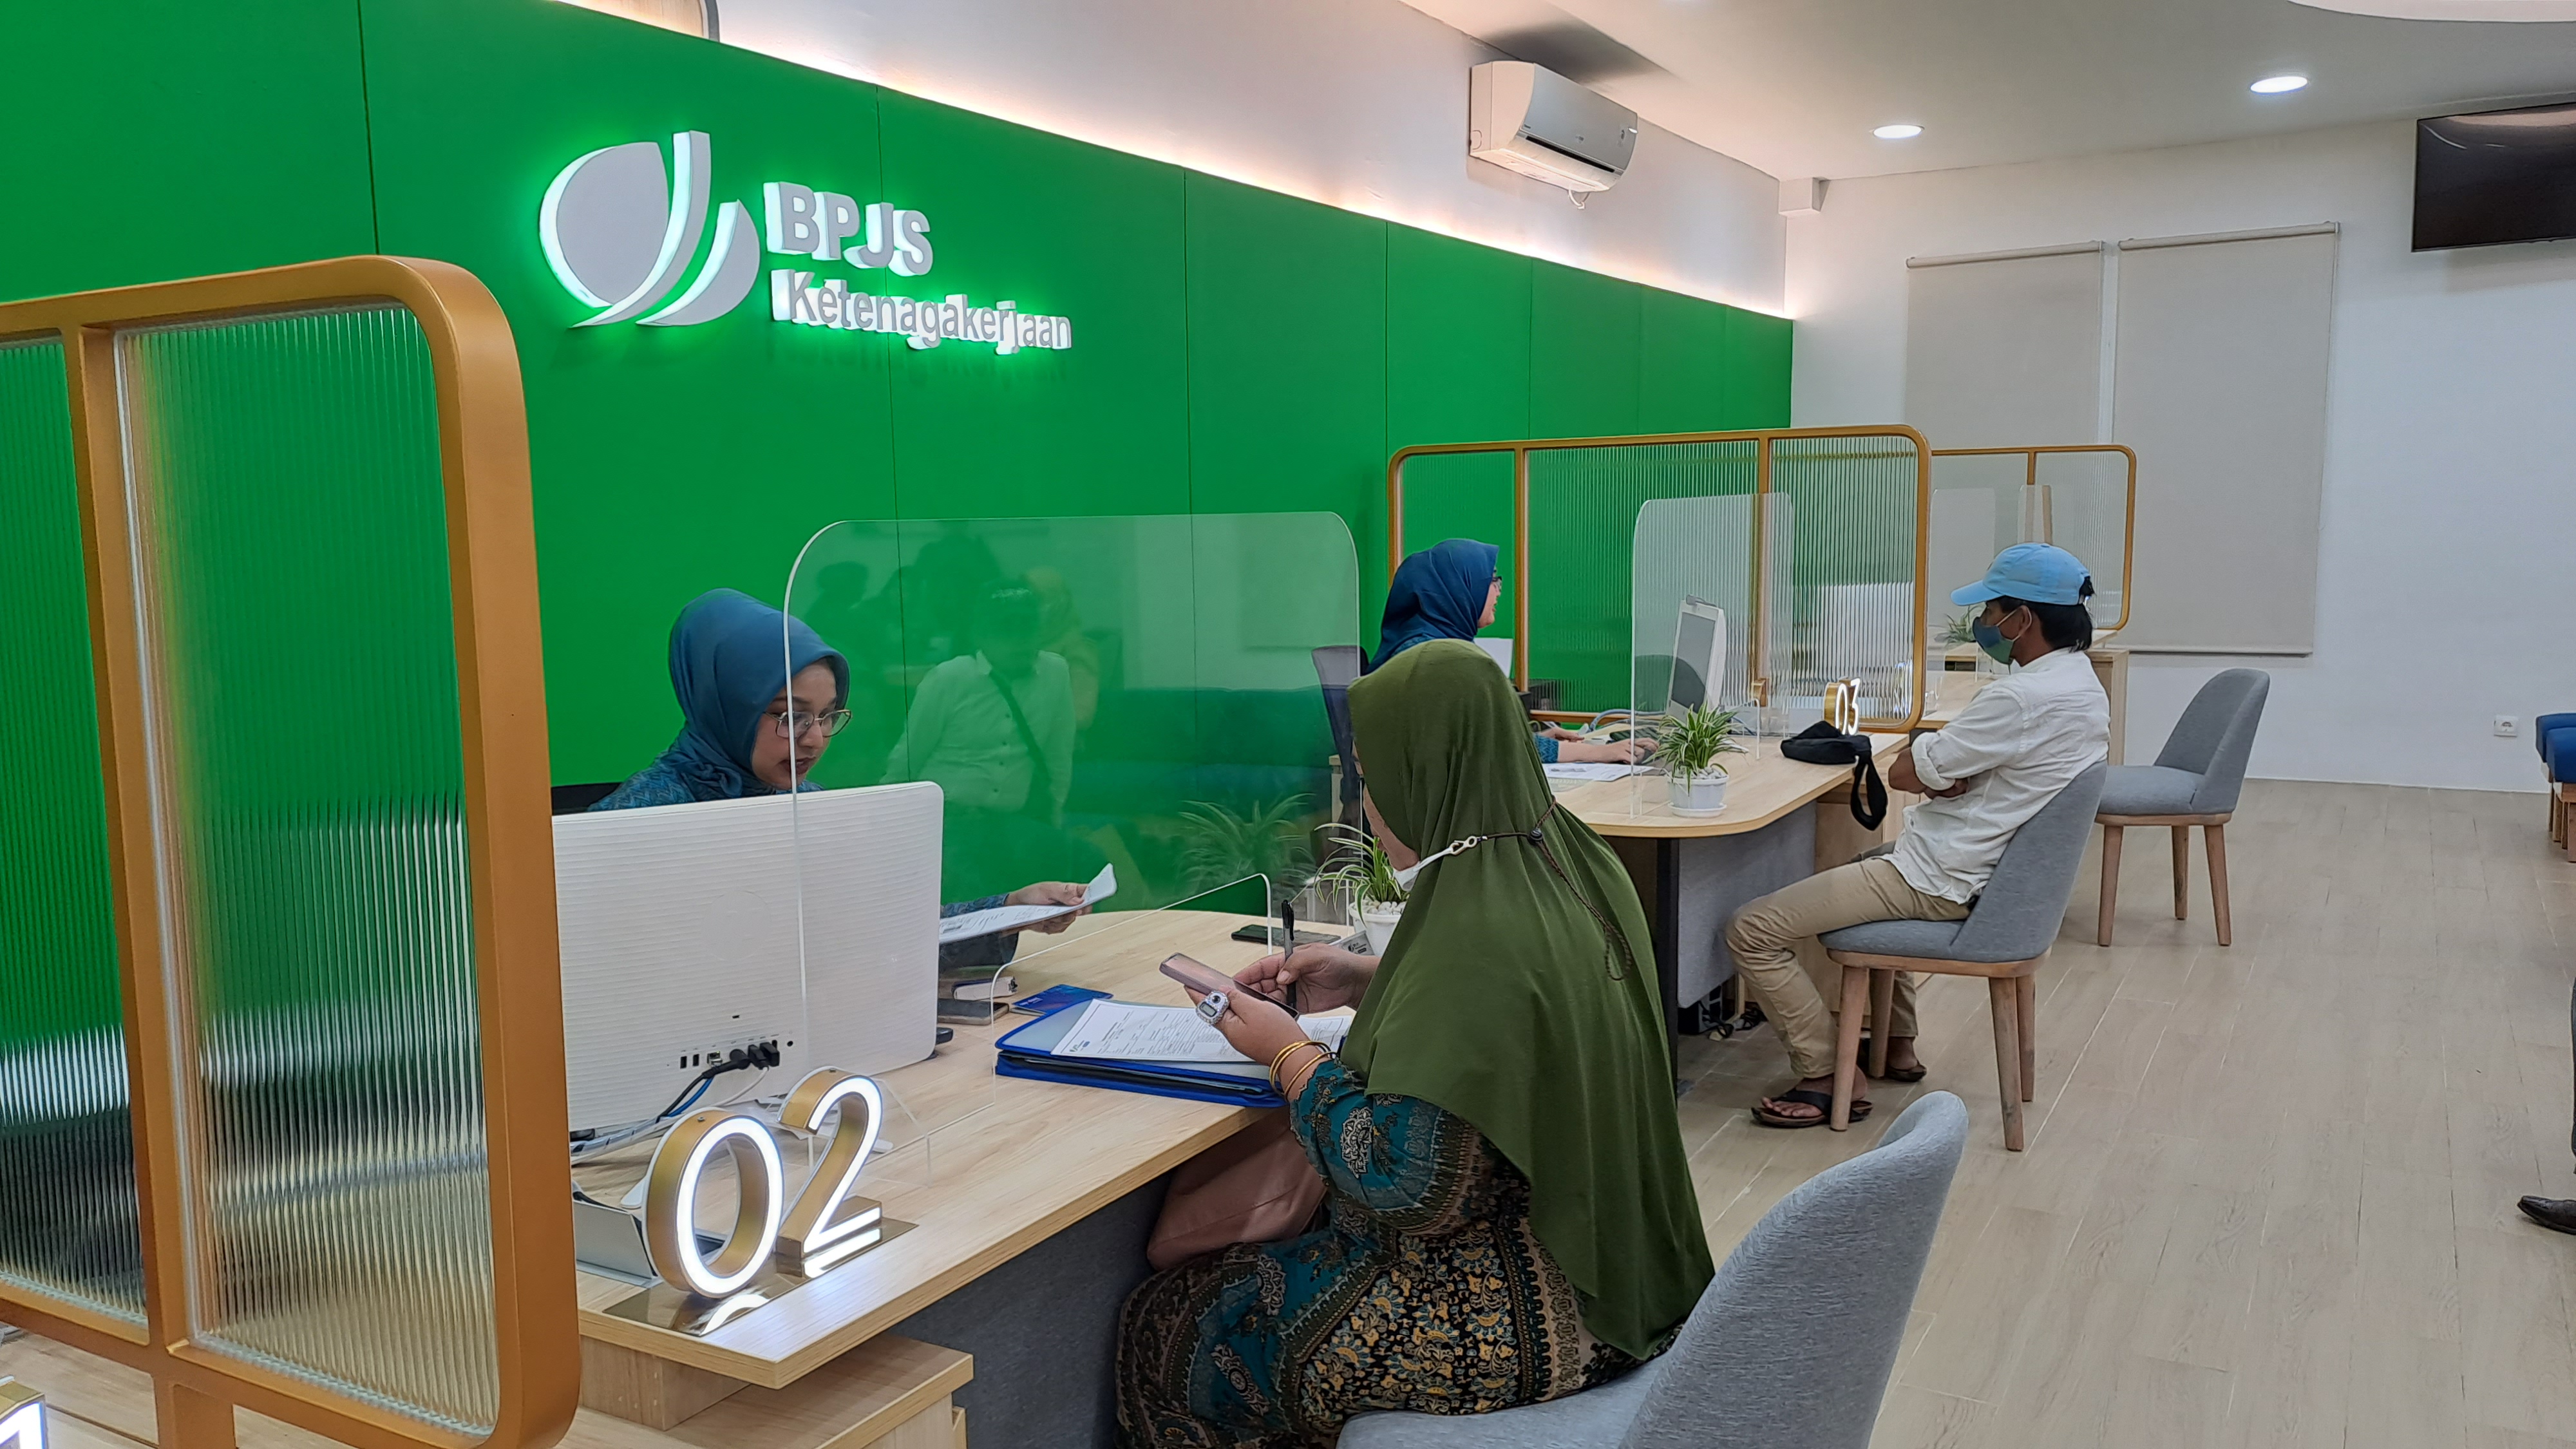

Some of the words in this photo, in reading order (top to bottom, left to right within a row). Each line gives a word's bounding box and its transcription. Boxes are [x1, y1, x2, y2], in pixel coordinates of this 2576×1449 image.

[764, 181, 934, 276] BPJS
[771, 269, 1072, 355] Ketenagakerjaan
[1826, 677, 1861, 735] 03
[647, 1066, 882, 1299] 02
